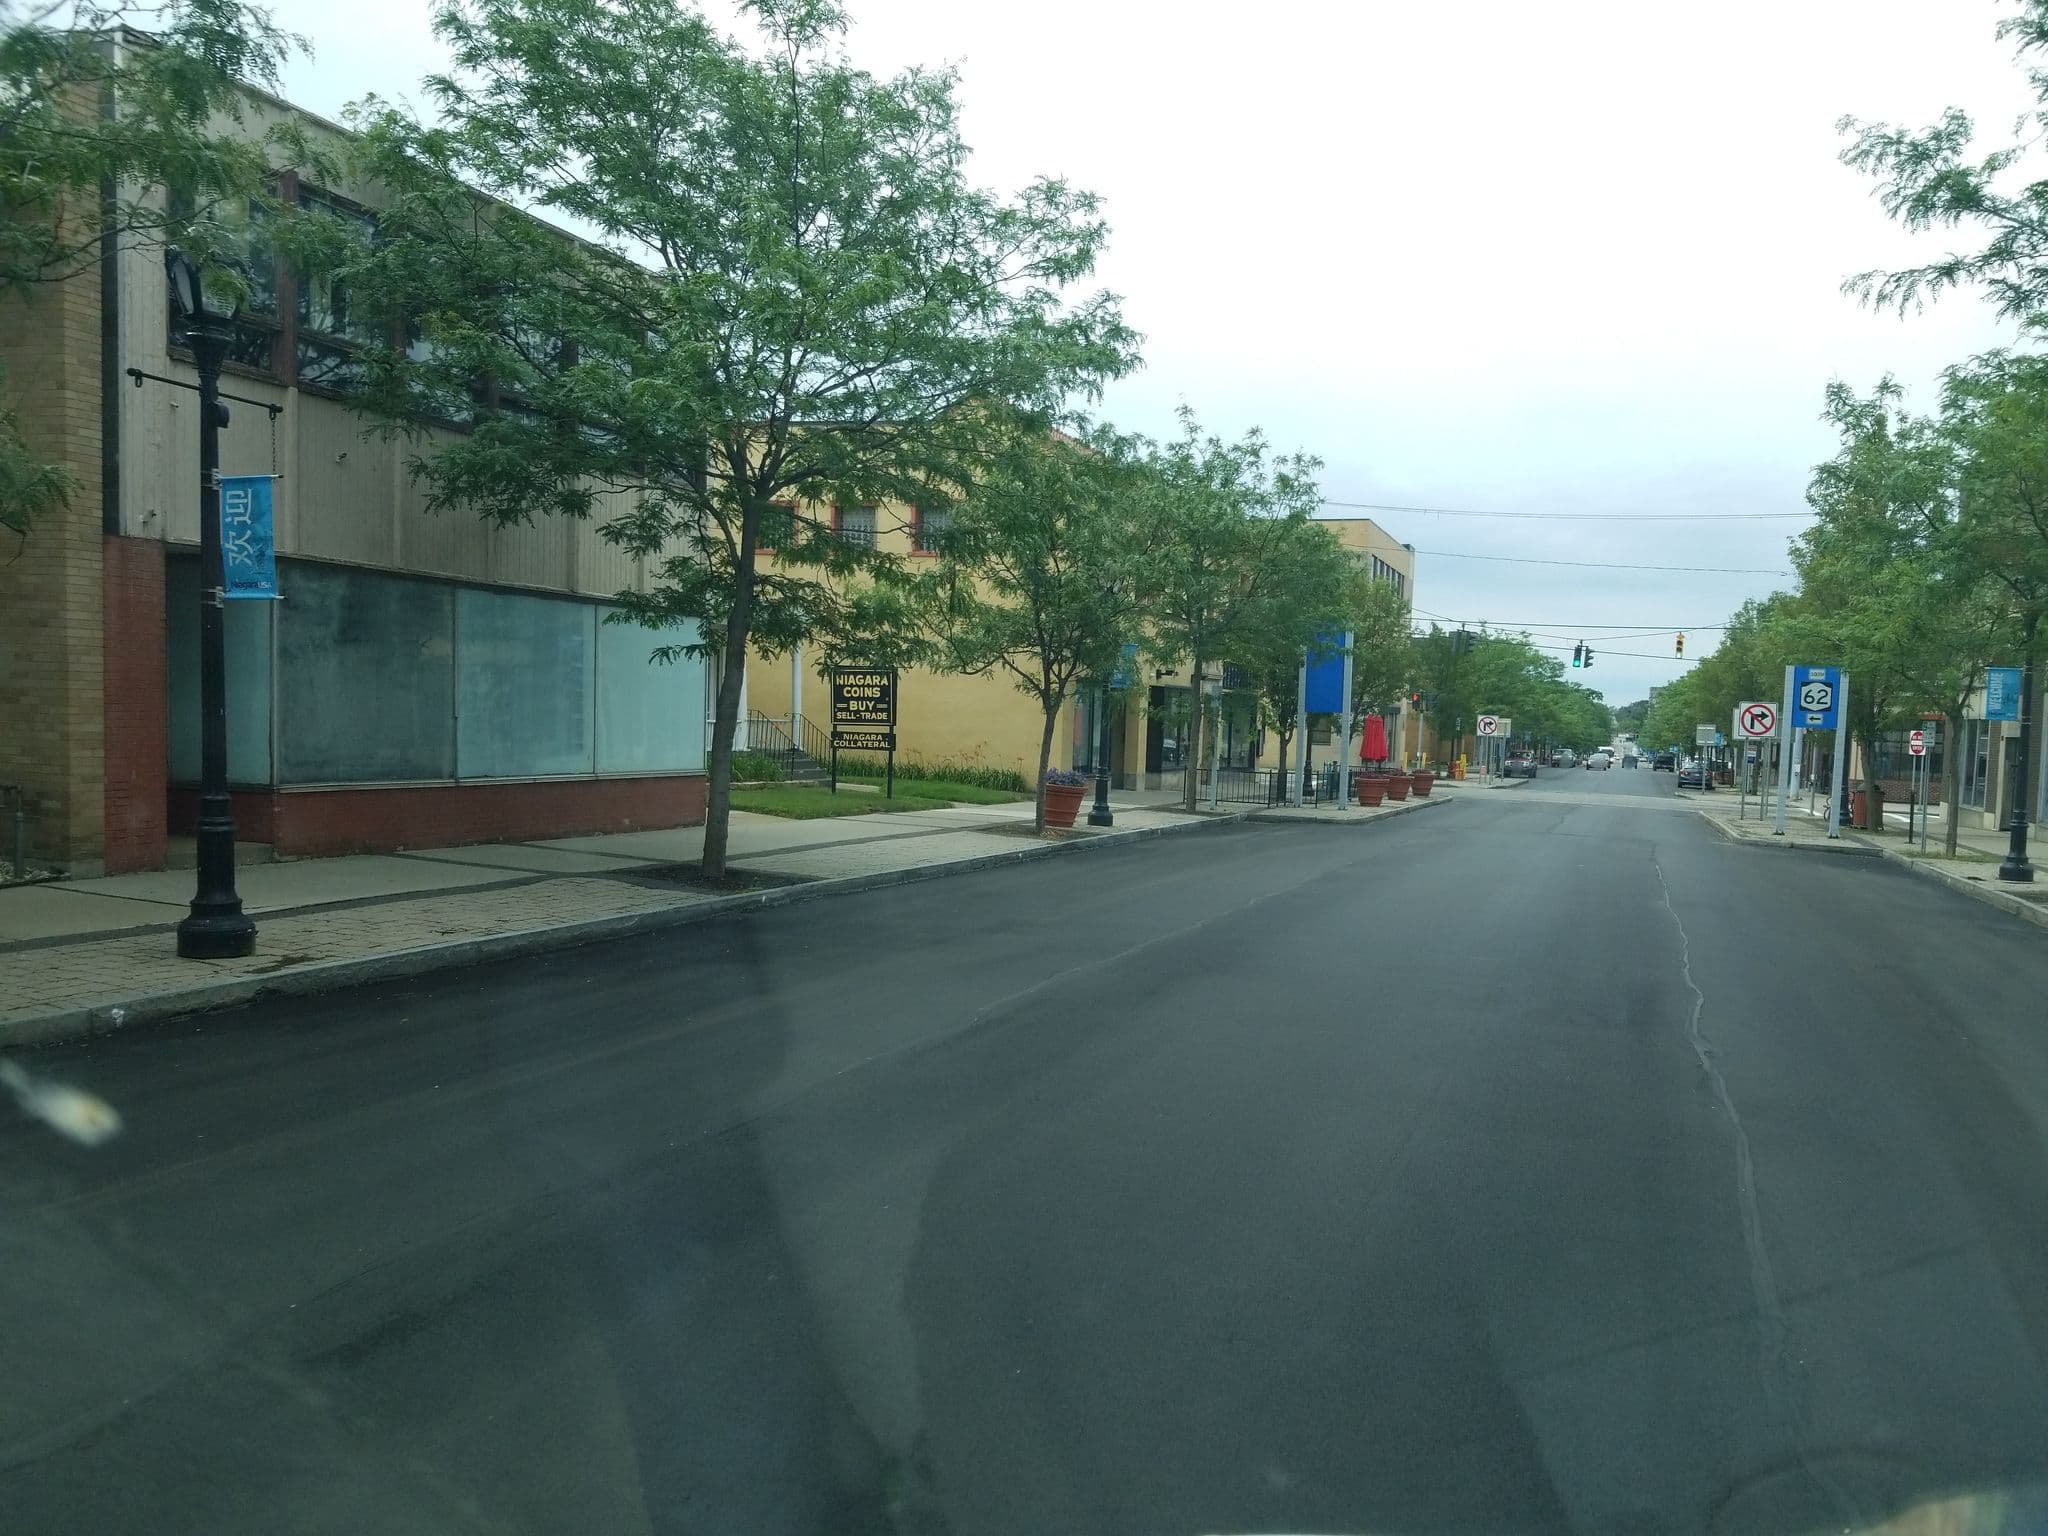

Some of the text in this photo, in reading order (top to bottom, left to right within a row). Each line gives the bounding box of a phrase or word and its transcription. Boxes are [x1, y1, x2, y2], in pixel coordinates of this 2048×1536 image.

[225, 488, 254, 567] 欢迎
[836, 675, 889, 685] NIAGARA
[843, 687, 881, 697] COINS
[1803, 689, 1829, 705] 62
[1988, 672, 2004, 711] WELCOME
[849, 701, 875, 710] BUY
